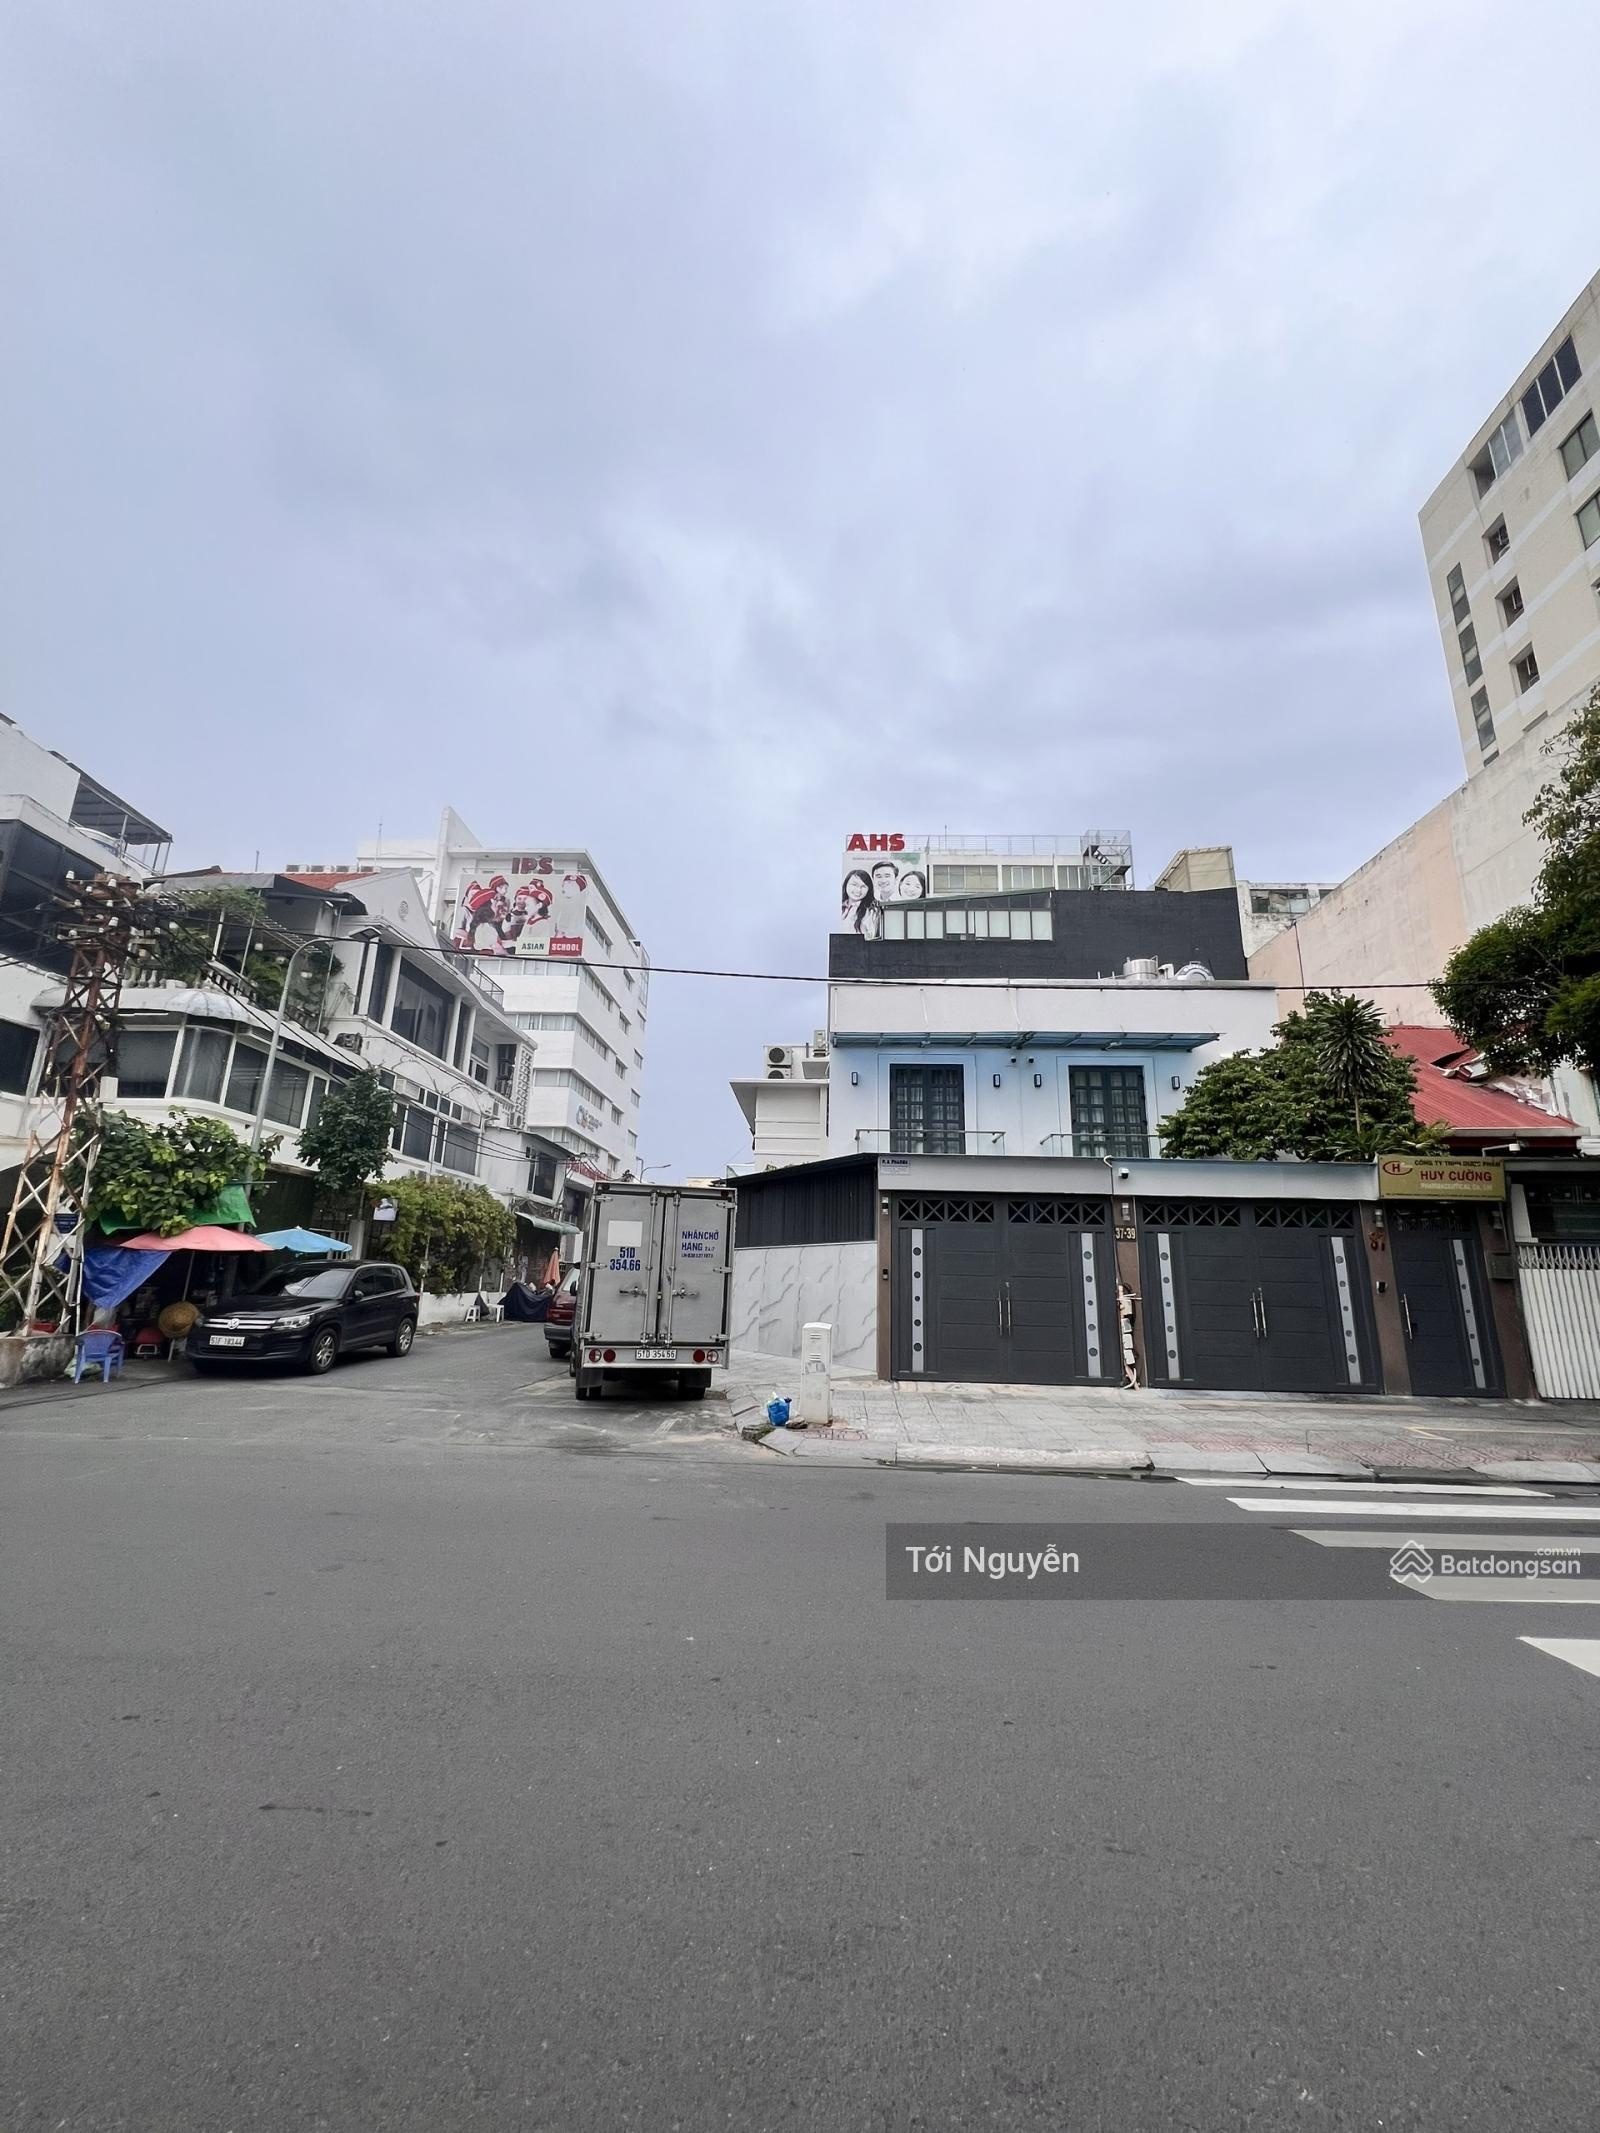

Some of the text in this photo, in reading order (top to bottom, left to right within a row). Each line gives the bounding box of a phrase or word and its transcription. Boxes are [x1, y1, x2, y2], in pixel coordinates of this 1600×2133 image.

[846, 833, 905, 851] AHS
[511, 857, 553, 874] IPS
[521, 943, 580, 951] ASIAN SCHOOL
[1420, 1168, 1492, 1181] HUY CƯỜNG
[619, 1246, 636, 1258] 51D
[609, 1259, 641, 1271] 354.66
